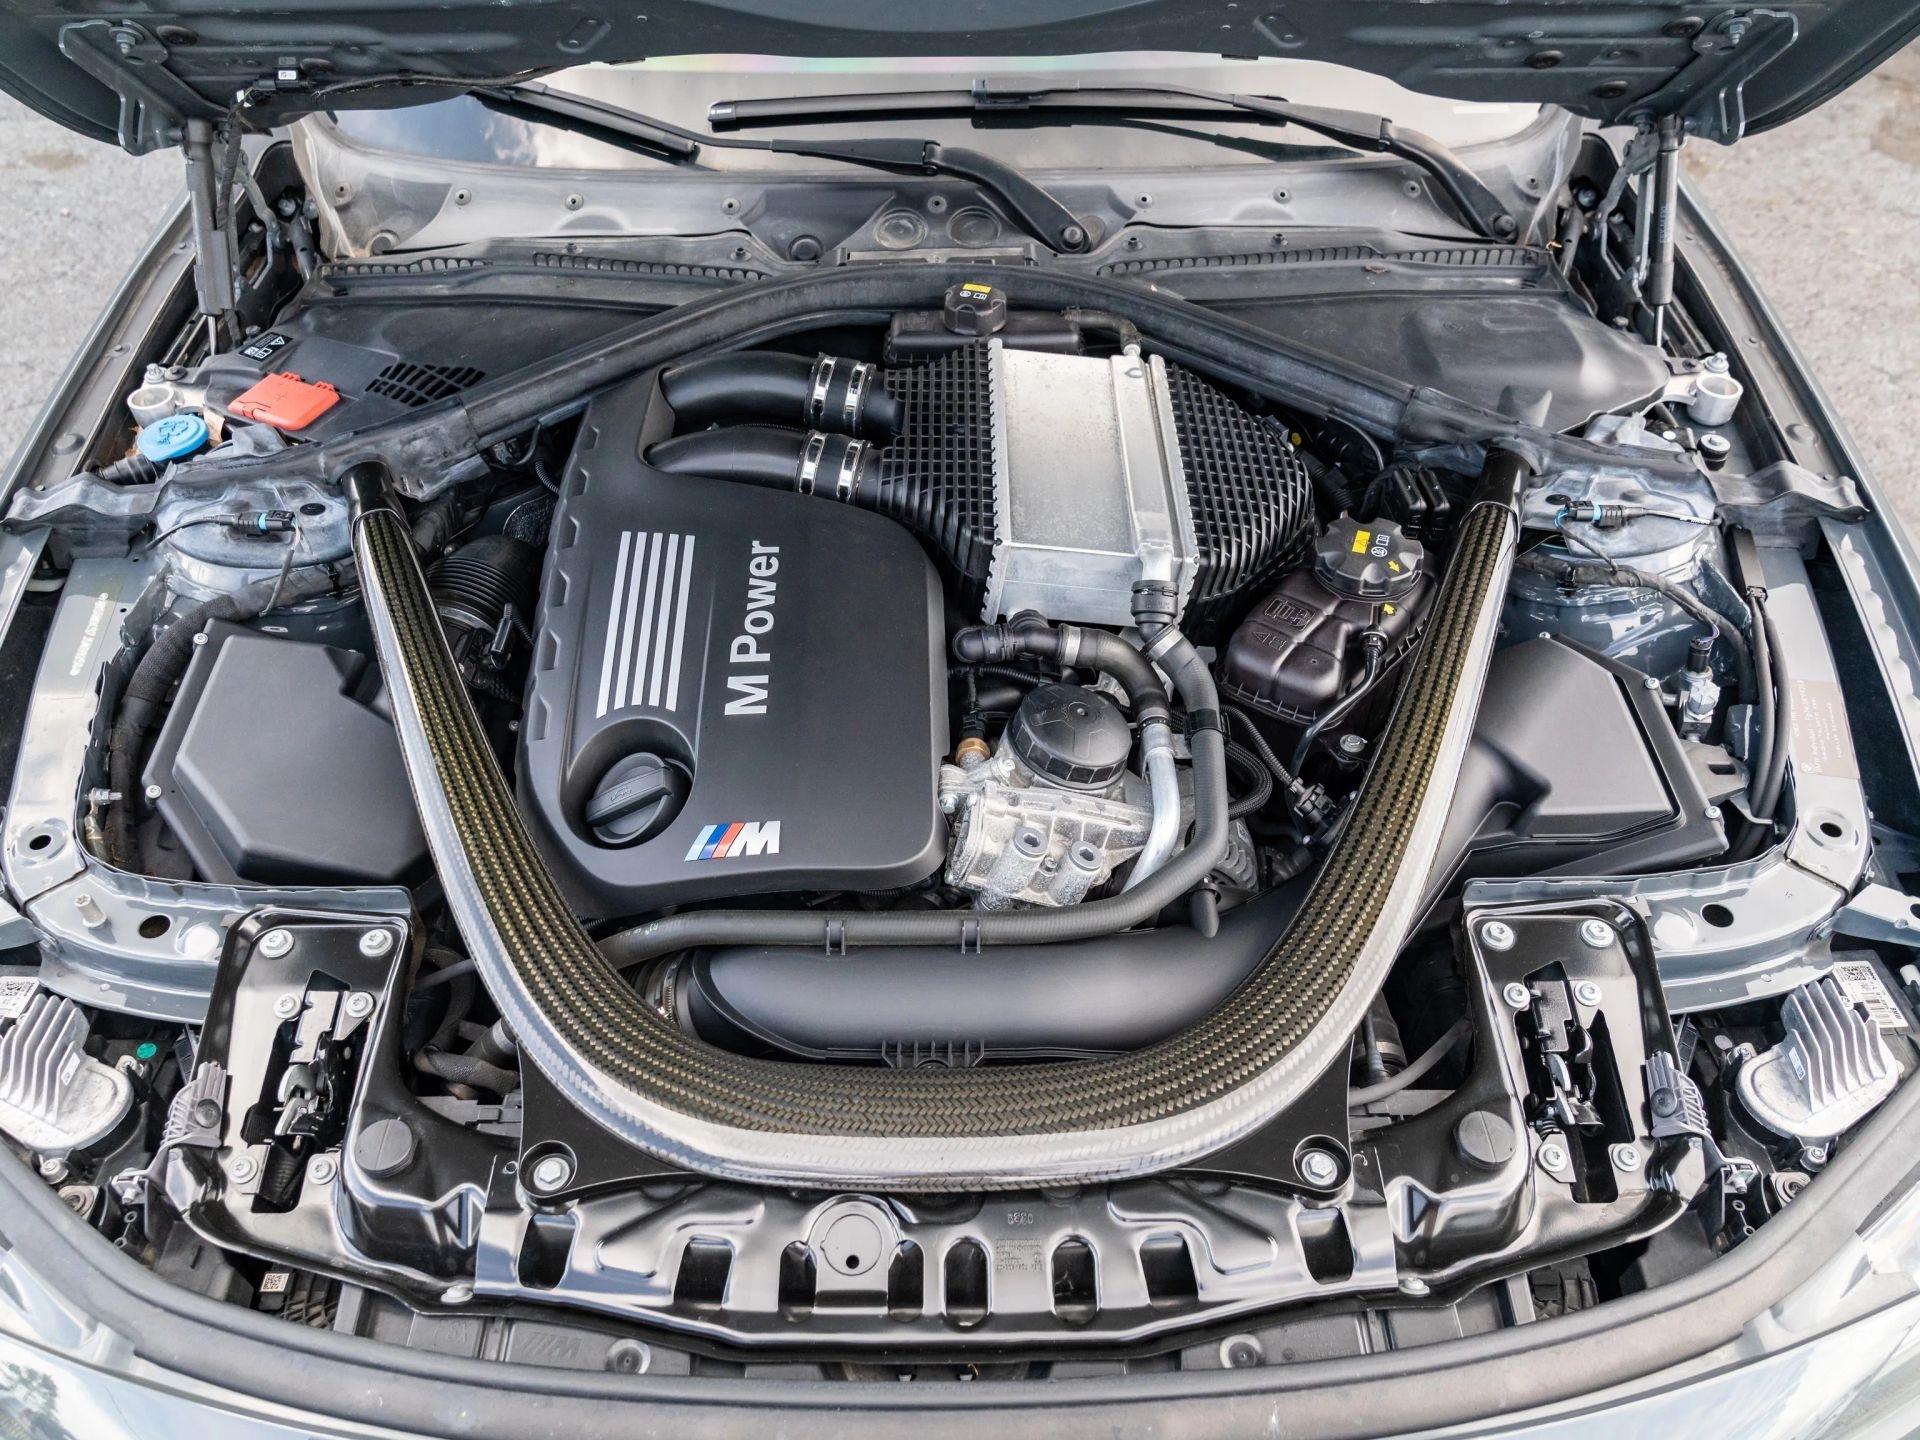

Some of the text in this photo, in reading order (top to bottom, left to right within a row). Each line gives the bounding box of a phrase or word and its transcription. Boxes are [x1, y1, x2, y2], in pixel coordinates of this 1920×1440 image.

[724, 540, 780, 715] M Power
[721, 820, 782, 858] M
